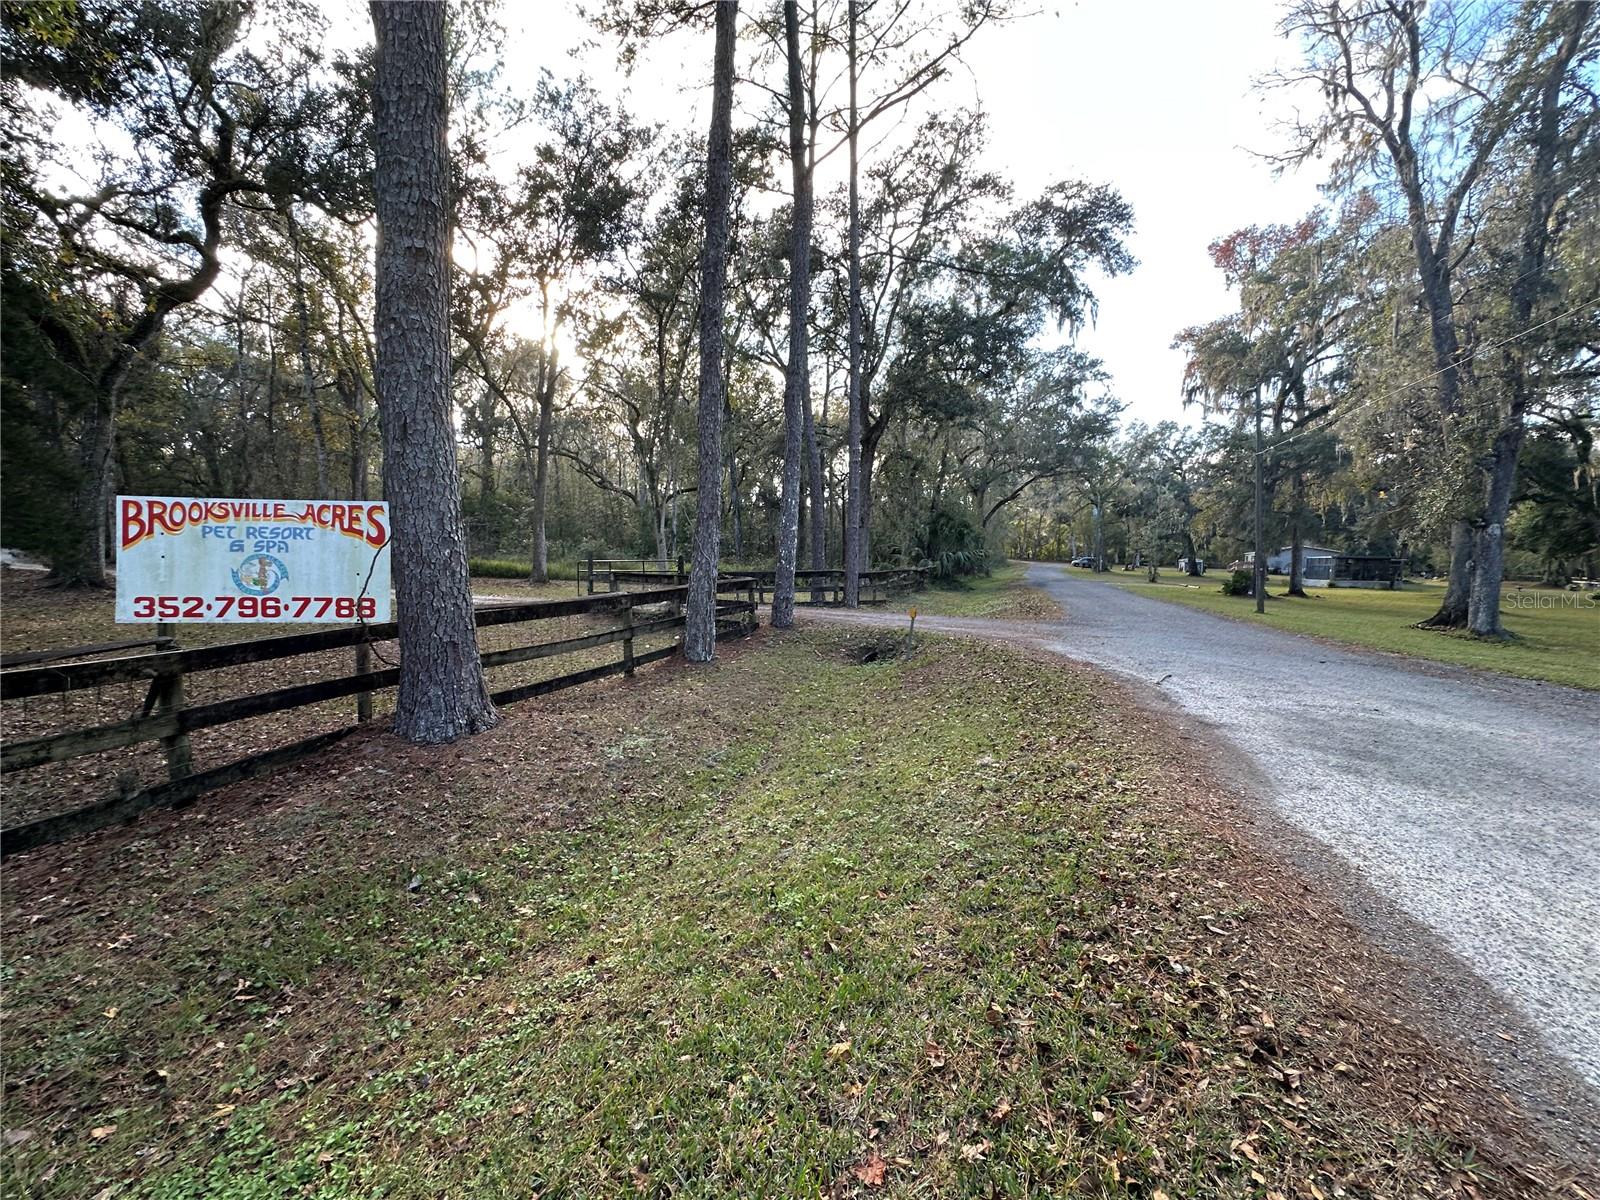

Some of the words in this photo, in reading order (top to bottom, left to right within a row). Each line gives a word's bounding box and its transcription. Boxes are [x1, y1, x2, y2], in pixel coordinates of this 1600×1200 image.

[122, 499, 300, 550] BROOKSVILLE
[304, 503, 386, 548] ACRES
[202, 525, 237, 539] PET
[246, 526, 315, 540] RESORT
[229, 539, 245, 552] &
[253, 540, 289, 553] SPA
